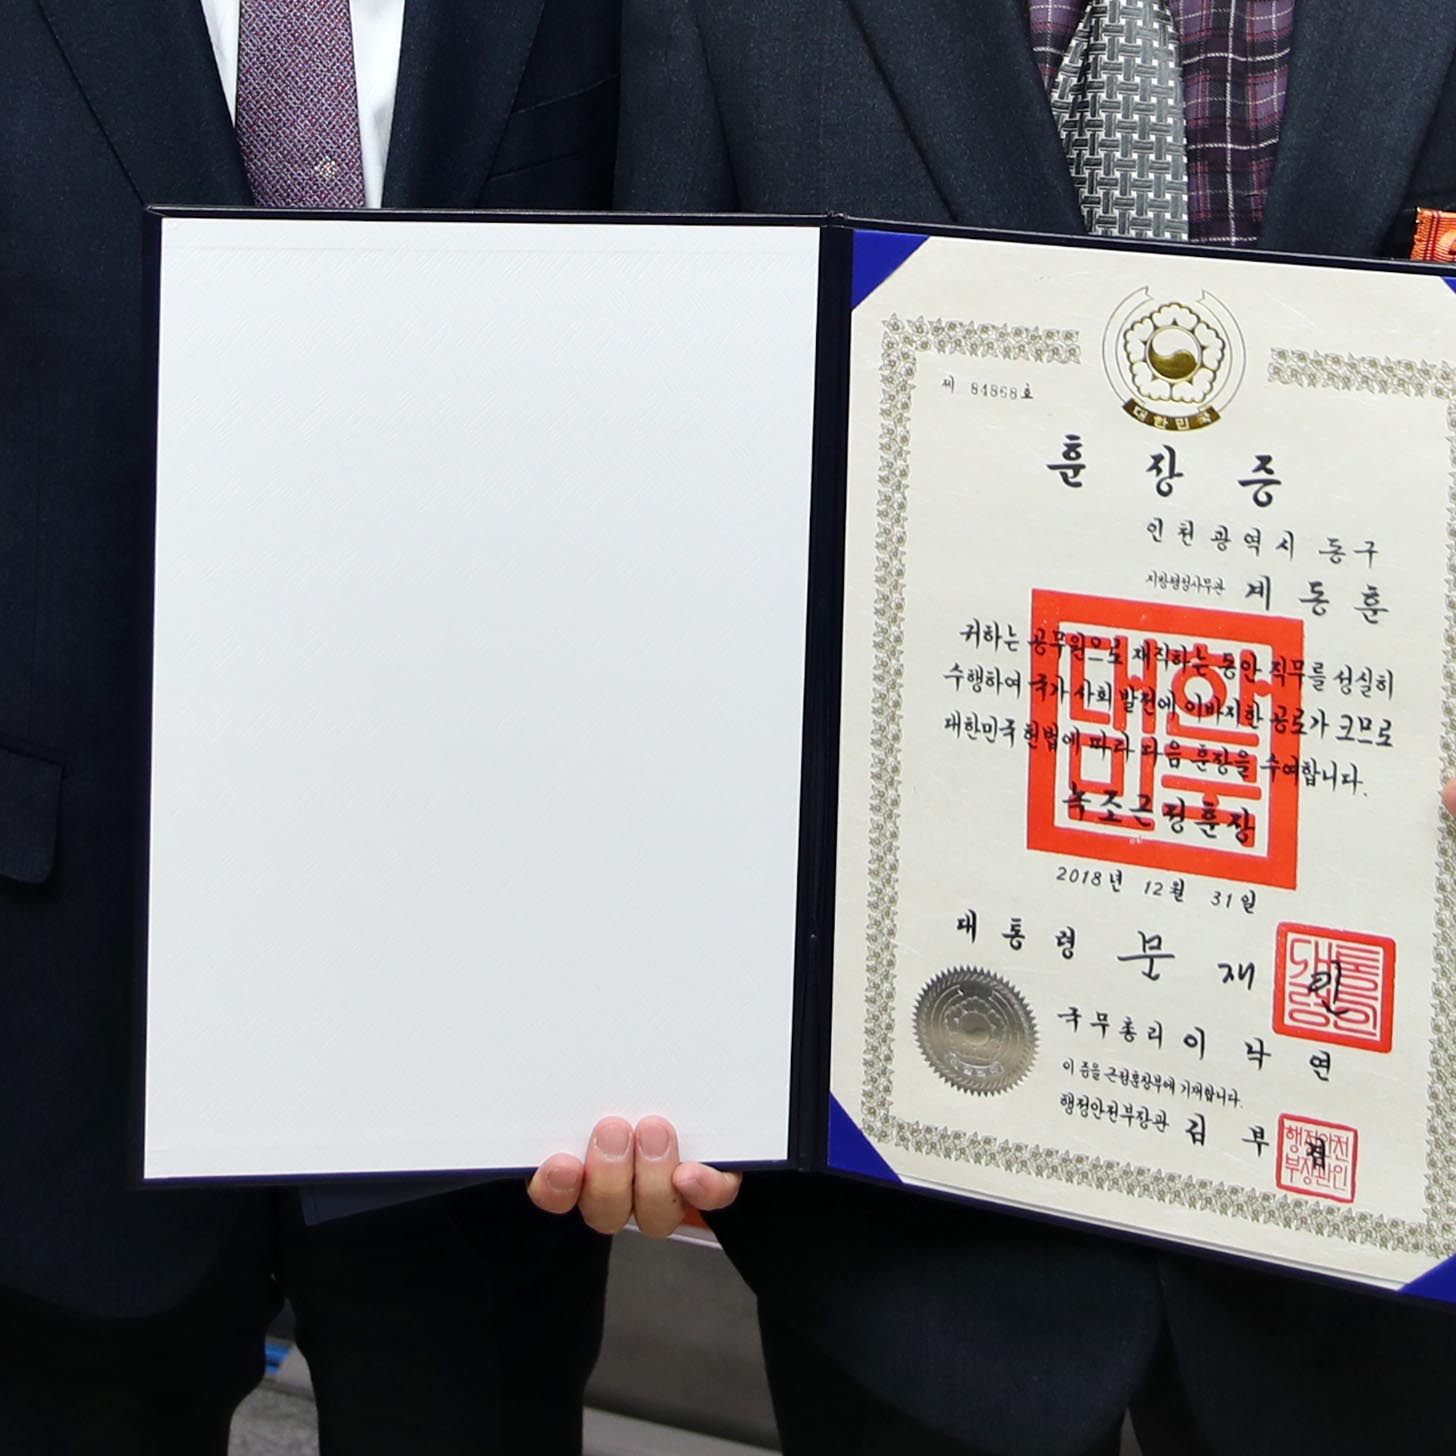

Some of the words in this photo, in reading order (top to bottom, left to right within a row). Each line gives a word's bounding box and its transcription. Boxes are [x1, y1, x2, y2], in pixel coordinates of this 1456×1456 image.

[1132, 404, 1213, 431] 대한민국
[960, 617, 1021, 653] 귀하는
[1026, 627, 1124, 665] 공무원으로
[1132, 638, 1210, 677] 재직하는
[1220, 652, 1262, 684] 동안
[1269, 655, 1327, 692] 직무를
[1333, 663, 1394, 701] 성실히
[944, 662, 1022, 700] 수행하여
[1119, 686, 1176, 719] 발전에
[1184, 692, 1264, 730] 이바지한
[1270, 704, 1329, 740] 공로가
[1334, 713, 1394, 748] 크므로
[944, 709, 1016, 749] 대한민국
[1023, 720, 1081, 754] 헌법에
[1088, 729, 1135, 764] 따라
[1140, 735, 1182, 770] 다음
[1190, 744, 1251, 781] 훈장을
[1060, 1092, 1170, 1134] 행정안전부장관
